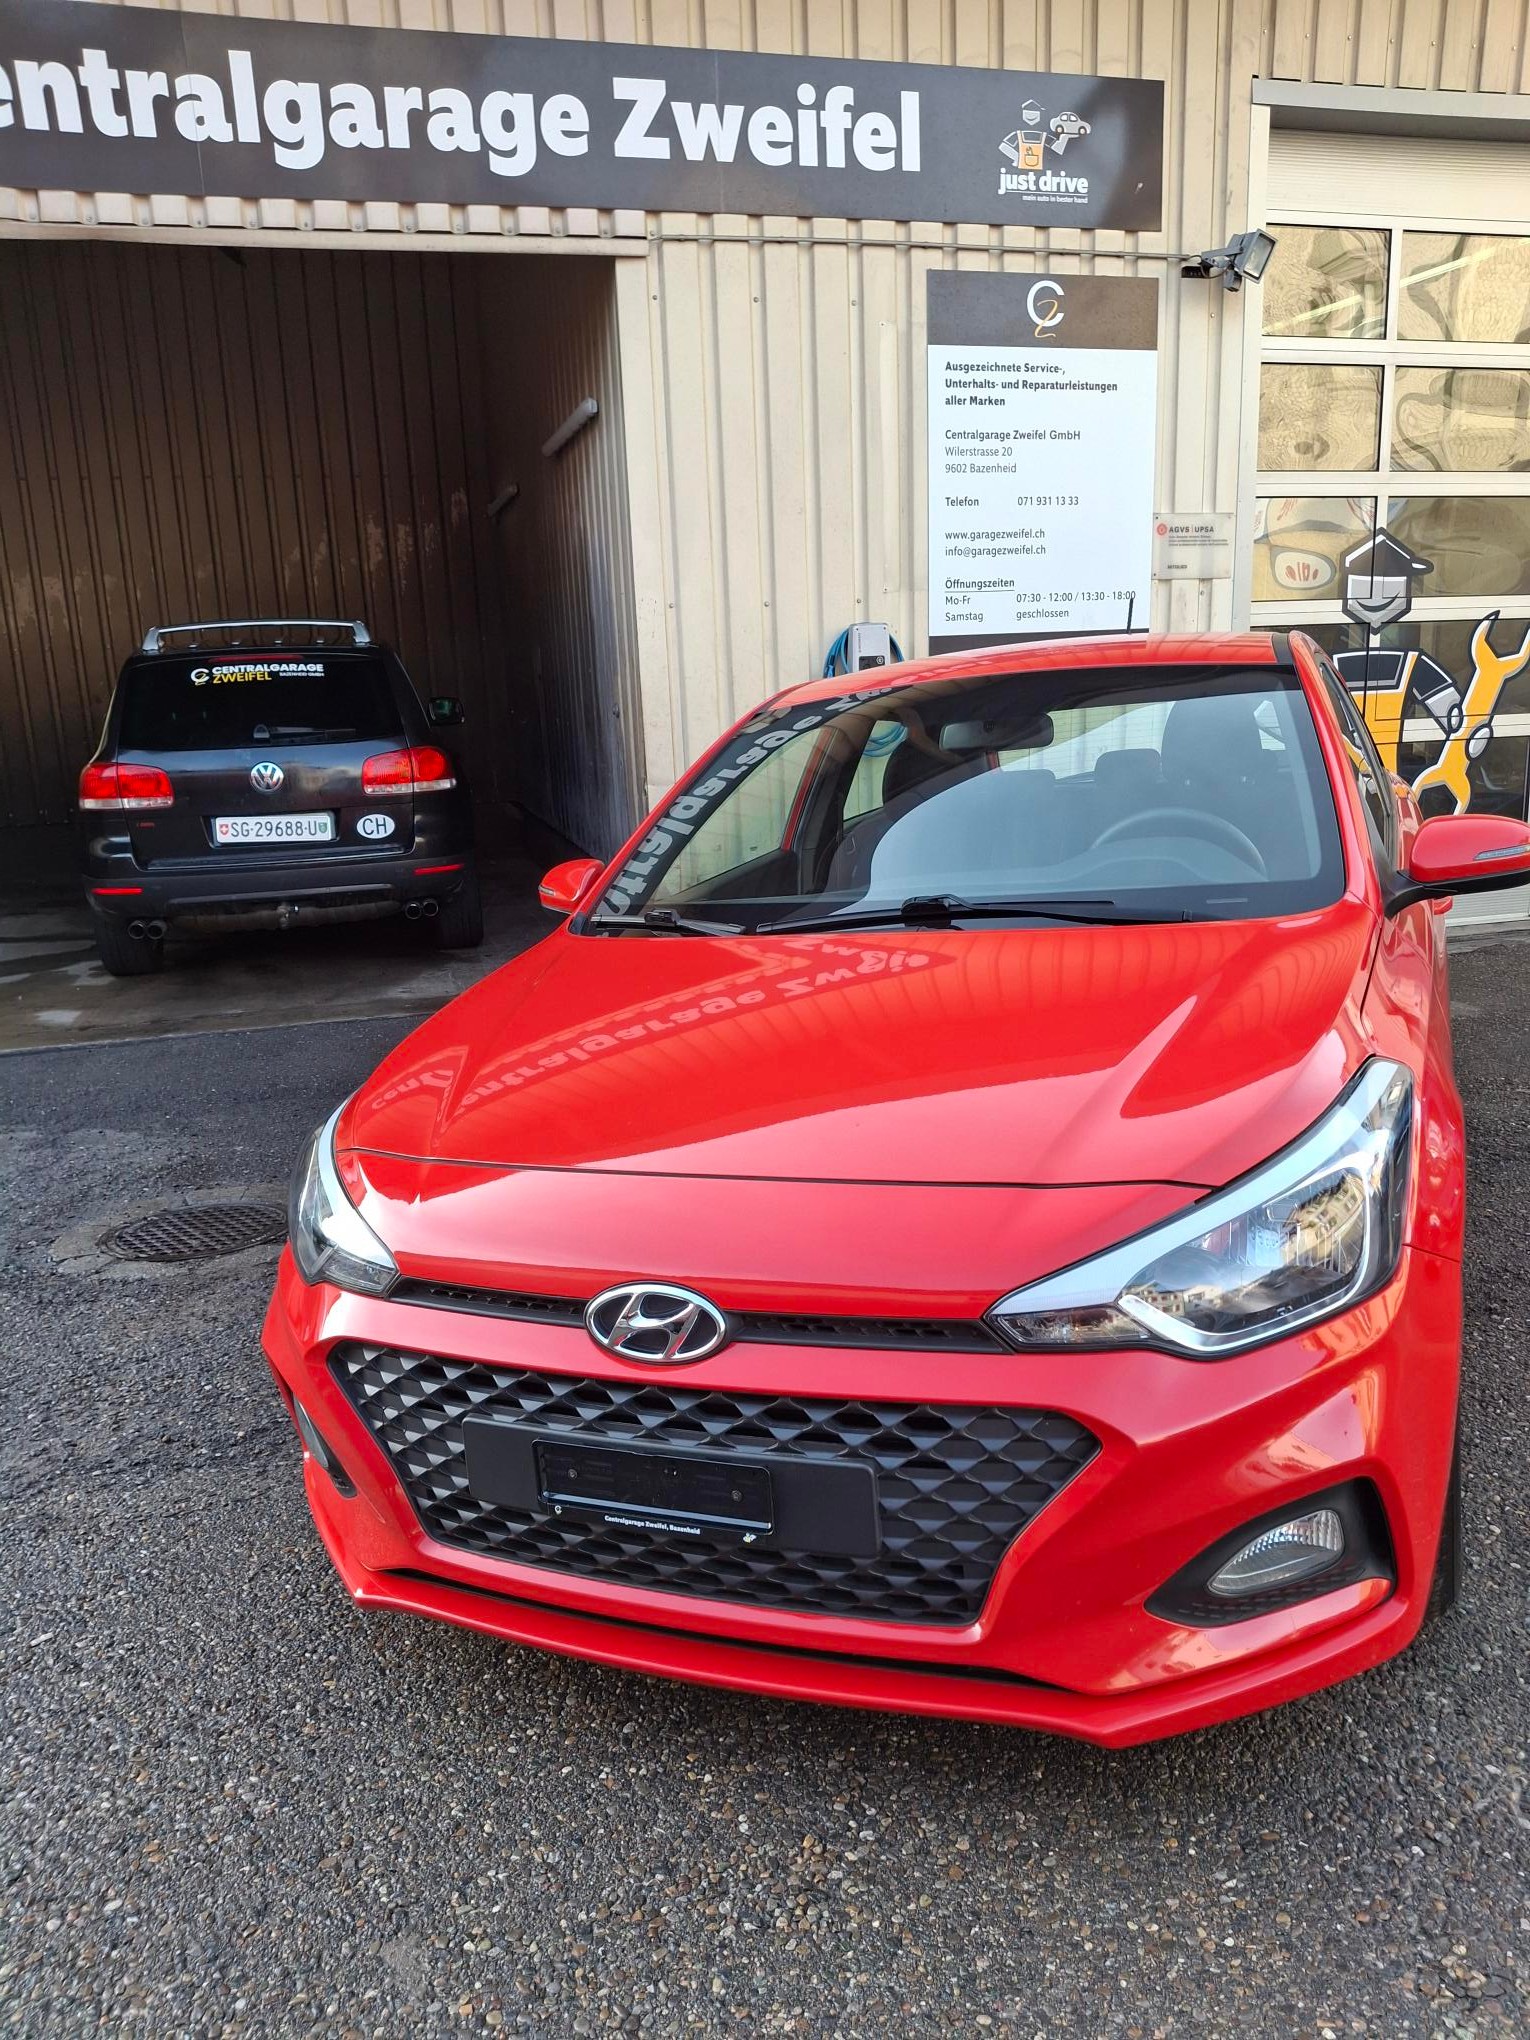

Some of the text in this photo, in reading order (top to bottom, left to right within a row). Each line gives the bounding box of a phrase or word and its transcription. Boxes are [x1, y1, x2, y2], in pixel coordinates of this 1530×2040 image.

[0, 49, 921, 177] ntralgarage Zweifel
[998, 167, 1088, 194] just drive
[945, 361, 1066, 375] Ausgezeichnete Service-,
[945, 379, 1118, 393] Unterhalts- und Reparaturleistungen
[945, 396, 1006, 406] aller Marken
[945, 430, 1081, 442] Centralgarage Zweifel GmbH
[945, 446, 1013, 456] Wilerstrasse 20
[945, 463, 1017, 473] 9602 Bazenheid
[945, 496, 1079, 507] Telefon 071 931 13 33
[945, 528, 1046, 542] www.garagezweifel.ch
[945, 544, 1047, 558] info@garagezweifel.ch
[945, 577, 1015, 590] Öffnungszeiten
[945, 595, 971, 605] Mo-Fr
[1016, 593, 1041, 603] 07:30
[1049, 592, 1073, 602] 12:00
[1082, 592, 1105, 602] 13:30
[1113, 590, 1137, 600] 18:00
[945, 609, 1070, 623] Samstag geschlossen
[211, 664, 324, 674] CENTRALGARAGE
[212, 672, 272, 683] ZWEIFEL
[362, 818, 388, 836] CH
